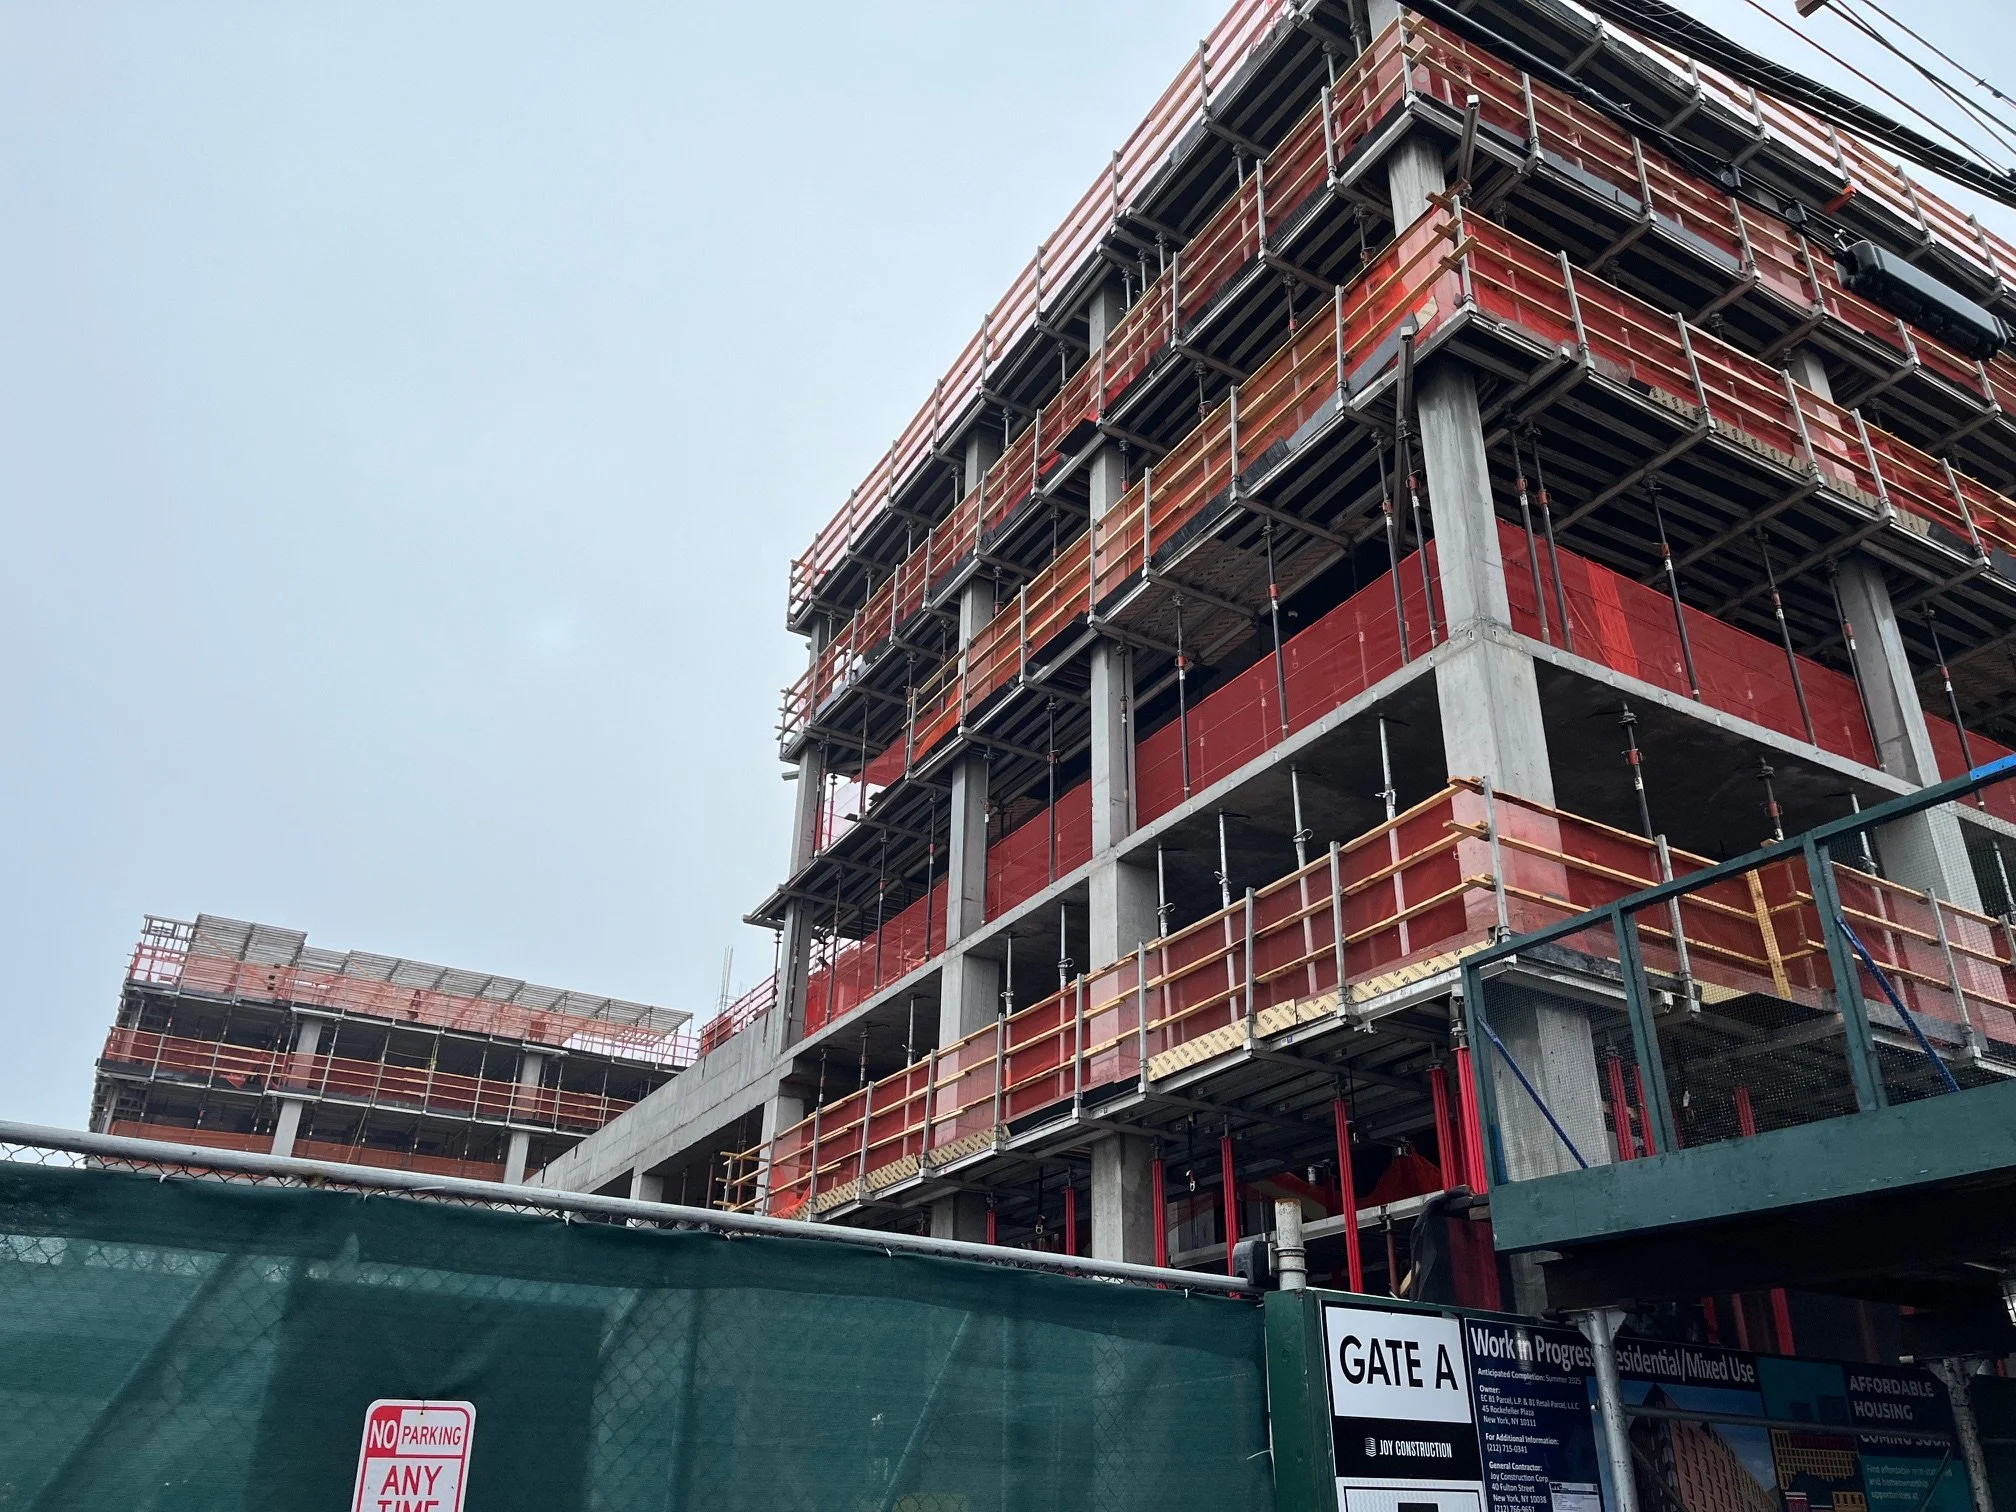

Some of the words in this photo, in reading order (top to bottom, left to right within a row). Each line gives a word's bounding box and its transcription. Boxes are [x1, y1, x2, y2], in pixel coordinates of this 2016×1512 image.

[1471, 1327, 1515, 1359] Work
[1517, 1331, 1533, 1360] in
[1616, 1345, 1728, 1382] esidential/Mixed
[1730, 1355, 1755, 1383] Use
[1340, 1335, 1423, 1388] GATE
[1435, 1343, 1459, 1390] A
[1477, 1368, 1510, 1379] Anticipated
[1511, 1371, 1545, 1381] Completion:
[1546, 1375, 1567, 1383] Summer
[1479, 1385, 1500, 1394] Owner:
[1850, 1375, 1935, 1398] AFFORDABLE
[1536, 1399, 1550, 1408] Retail
[1489, 1405, 1520, 1414] Rockefeller
[1520, 1407, 1534, 1416] Plaza
[1853, 1400, 1913, 1420] HOUSING
[1483, 1415, 1496, 1423] New
[1496, 1416, 1511, 1426] York,
[369, 1419, 398, 1449] NO
[402, 1426, 461, 1445] PARKING
[1485, 1432, 1495, 1440] For
[1495, 1433, 1524, 1443] Additional
[1525, 1436, 1560, 1446] Information:
[1379, 1440, 1393, 1456] JOY
[1395, 1441, 1453, 1458] CONSTRUCTION
[1487, 1443, 1502, 1454] (212)
[1488, 1461, 1511, 1470] General
[1511, 1463, 1543, 1472] Contractor:
[380, 1465, 443, 1496] ANY
[1490, 1472, 1500, 1482] Joy
[1500, 1473, 1534, 1482] Construction
[1500, 1483, 1518, 1492] Fulton
[1518, 1484, 1535, 1493] Street
[1492, 1494, 1507, 1502] New
[1507, 1494, 1520, 1504] York,
[1521, 1495, 1529, 1503] NY
